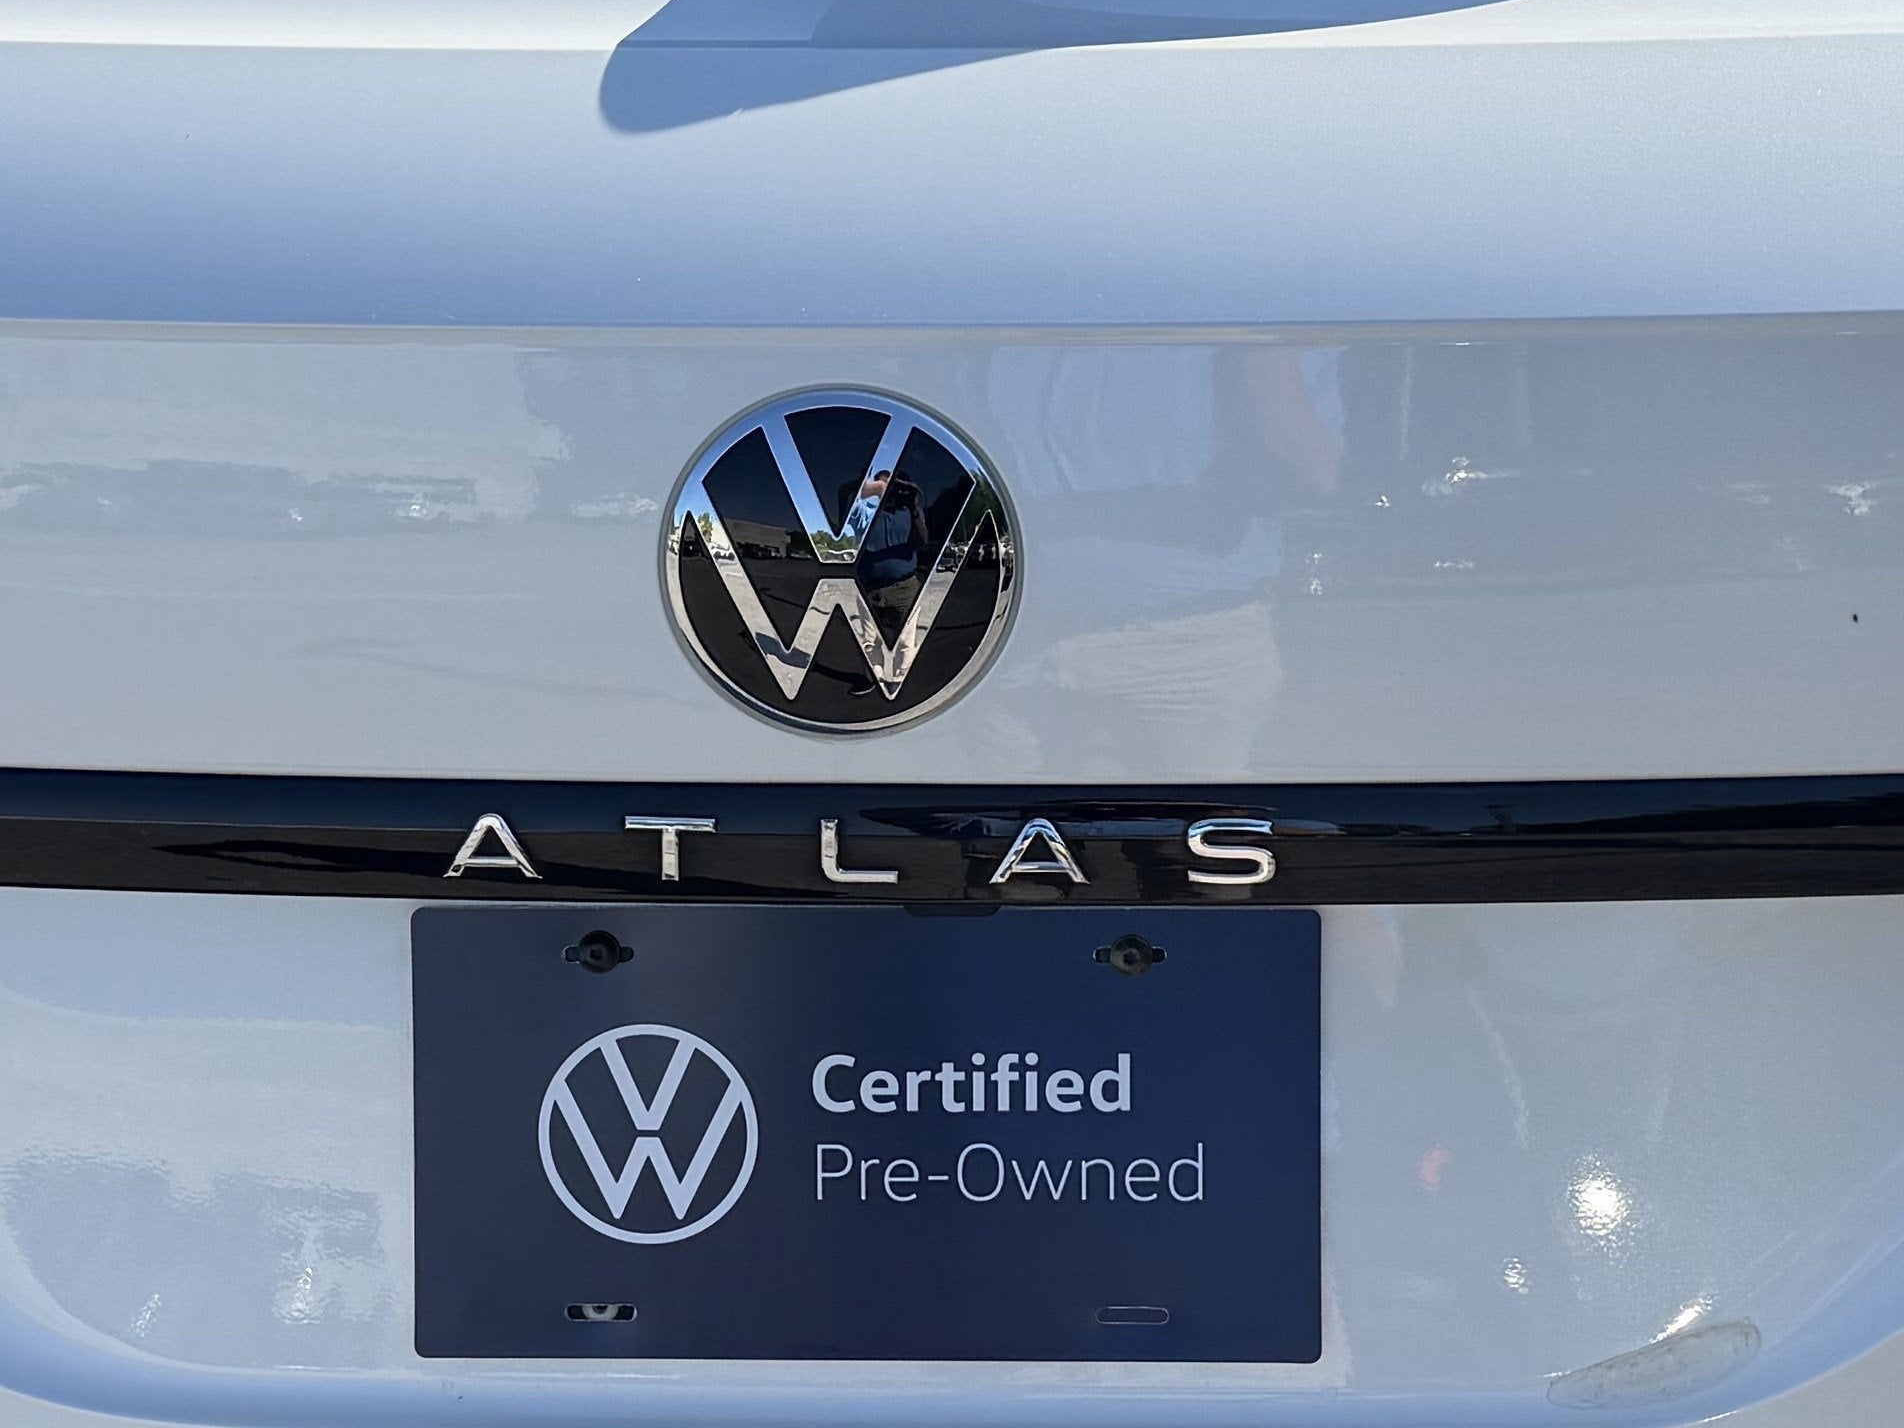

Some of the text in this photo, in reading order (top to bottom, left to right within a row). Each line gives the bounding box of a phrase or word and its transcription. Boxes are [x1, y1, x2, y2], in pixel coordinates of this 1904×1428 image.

[441, 811, 1279, 887] ATLAS
[810, 1052, 1133, 1113] Certified
[813, 1142, 1207, 1204] Pre-Owned
